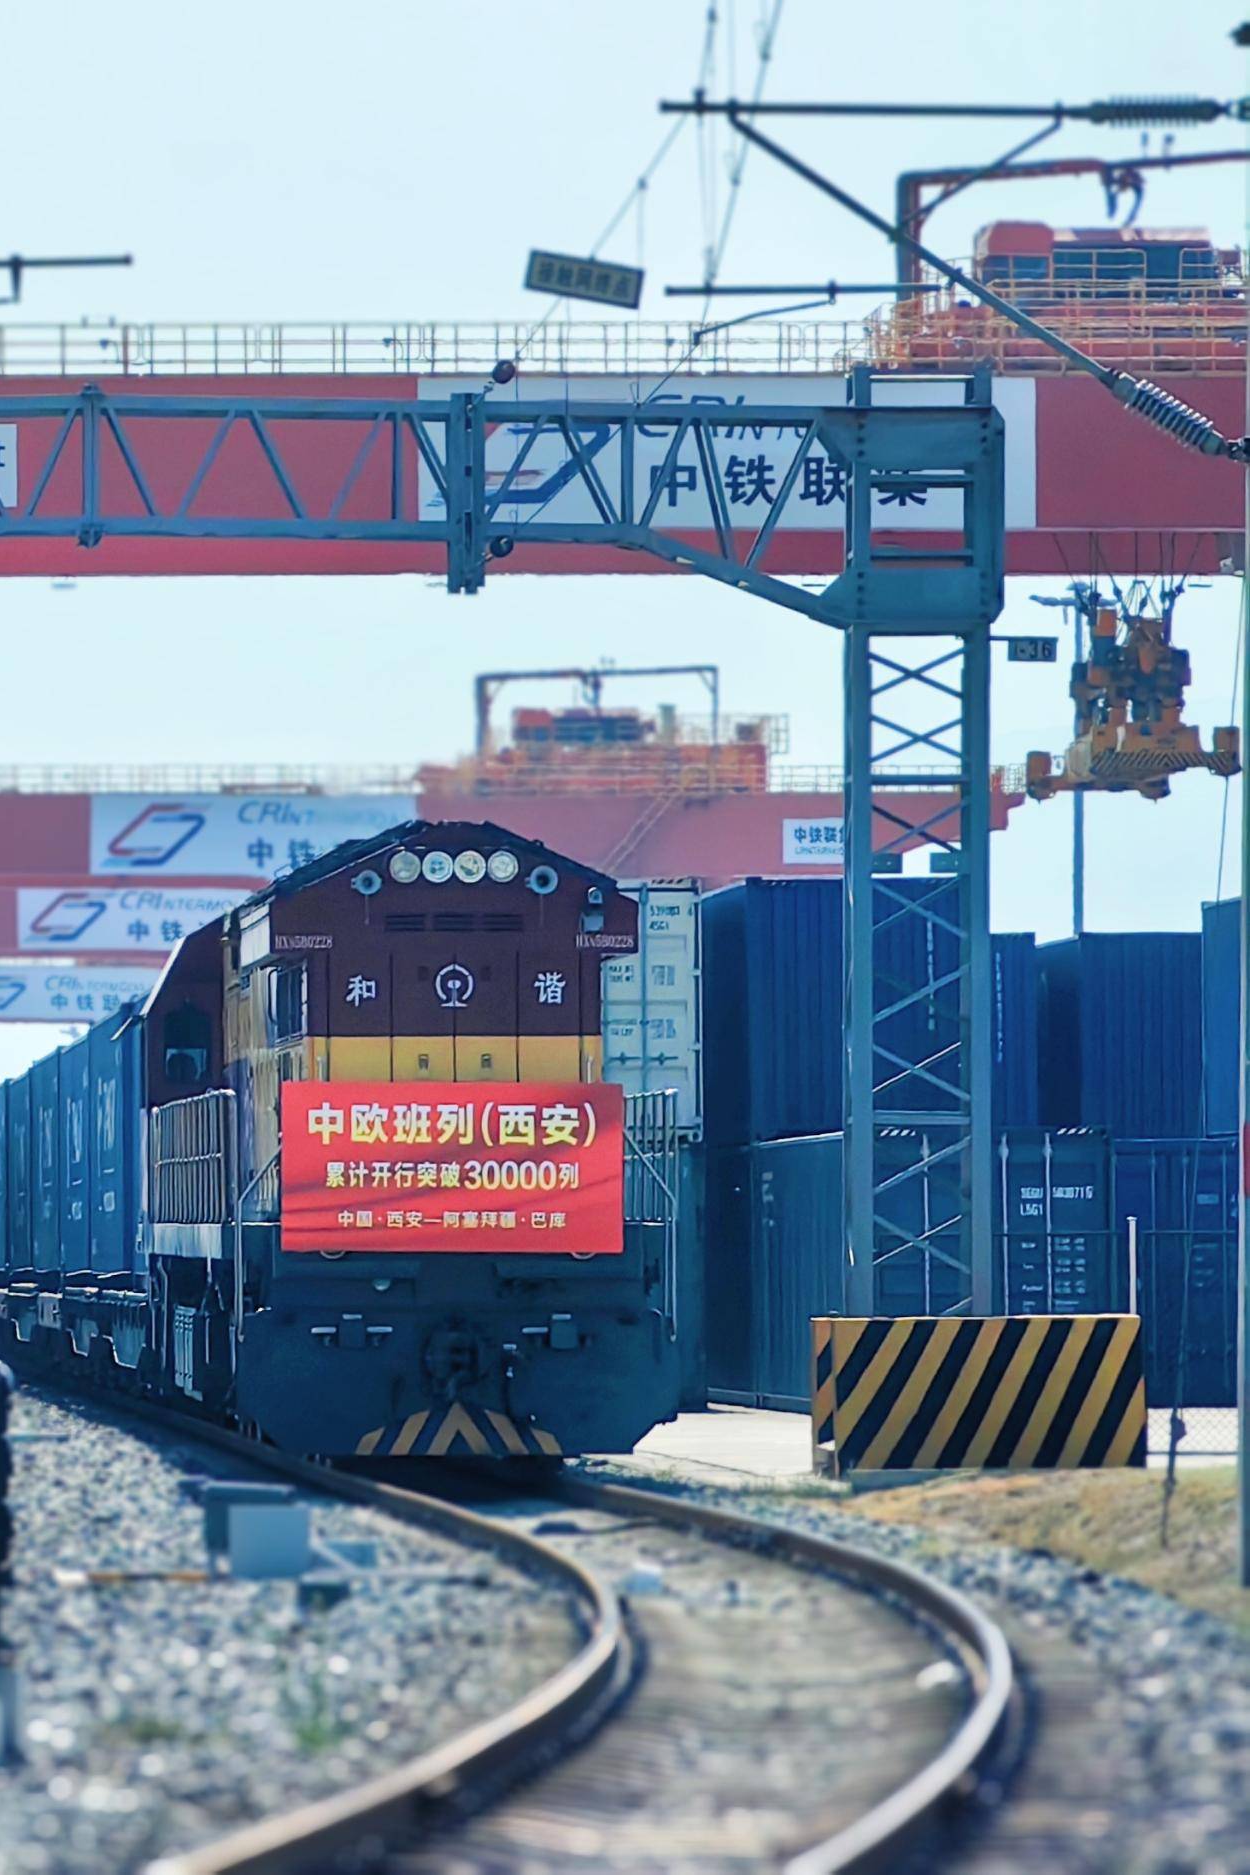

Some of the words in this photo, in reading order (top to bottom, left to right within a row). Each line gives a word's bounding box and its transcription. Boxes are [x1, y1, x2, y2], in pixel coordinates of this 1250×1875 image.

[346, 974, 377, 1007] 和
[534, 972, 567, 1005] 谐
[308, 1101, 597, 1147] 中欧班列(西安)
[325, 1160, 580, 1191] 累计开行突破30000列
